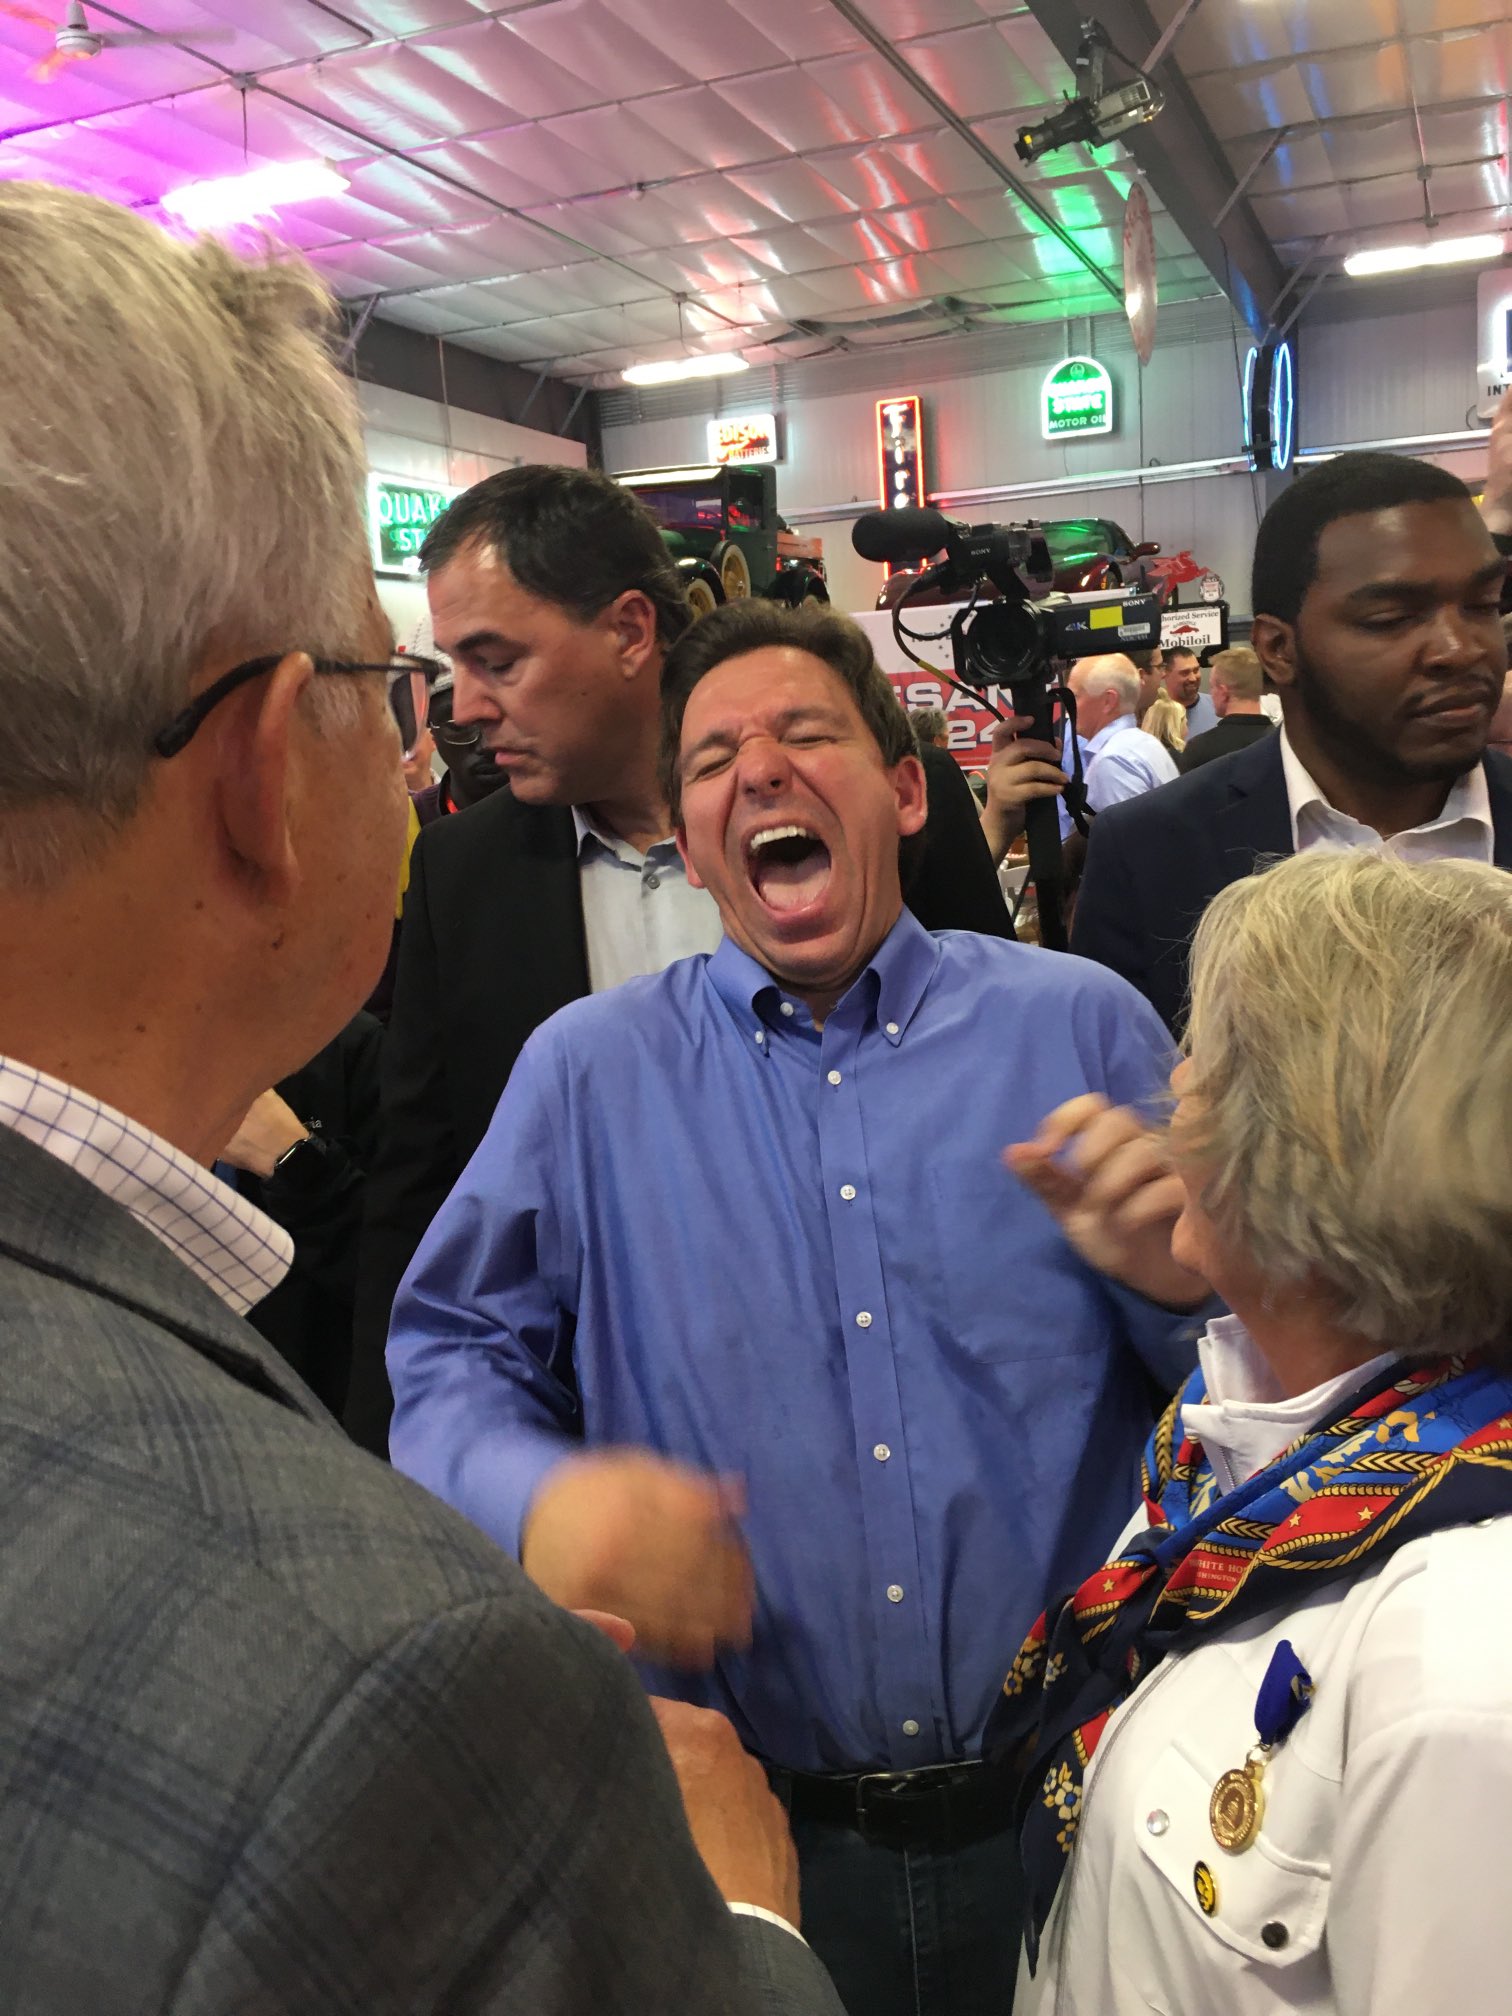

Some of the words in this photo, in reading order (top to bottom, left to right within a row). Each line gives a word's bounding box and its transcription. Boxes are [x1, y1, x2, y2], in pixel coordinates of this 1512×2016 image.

[1487, 383, 1510, 397] INT
[1048, 417, 1088, 429] MOTOR
[1090, 414, 1105, 424] OIL
[379, 490, 450, 525] QUAK
[398, 528, 428, 551] ST
[970, 547, 991, 556] SONY
[1122, 600, 1146, 608] SONY
[1161, 613, 1190, 622] horized
[1191, 611, 1219, 619] Service
[1160, 634, 1211, 647] Mobiloil
[1197, 1572, 1237, 1582] SHINGTON
